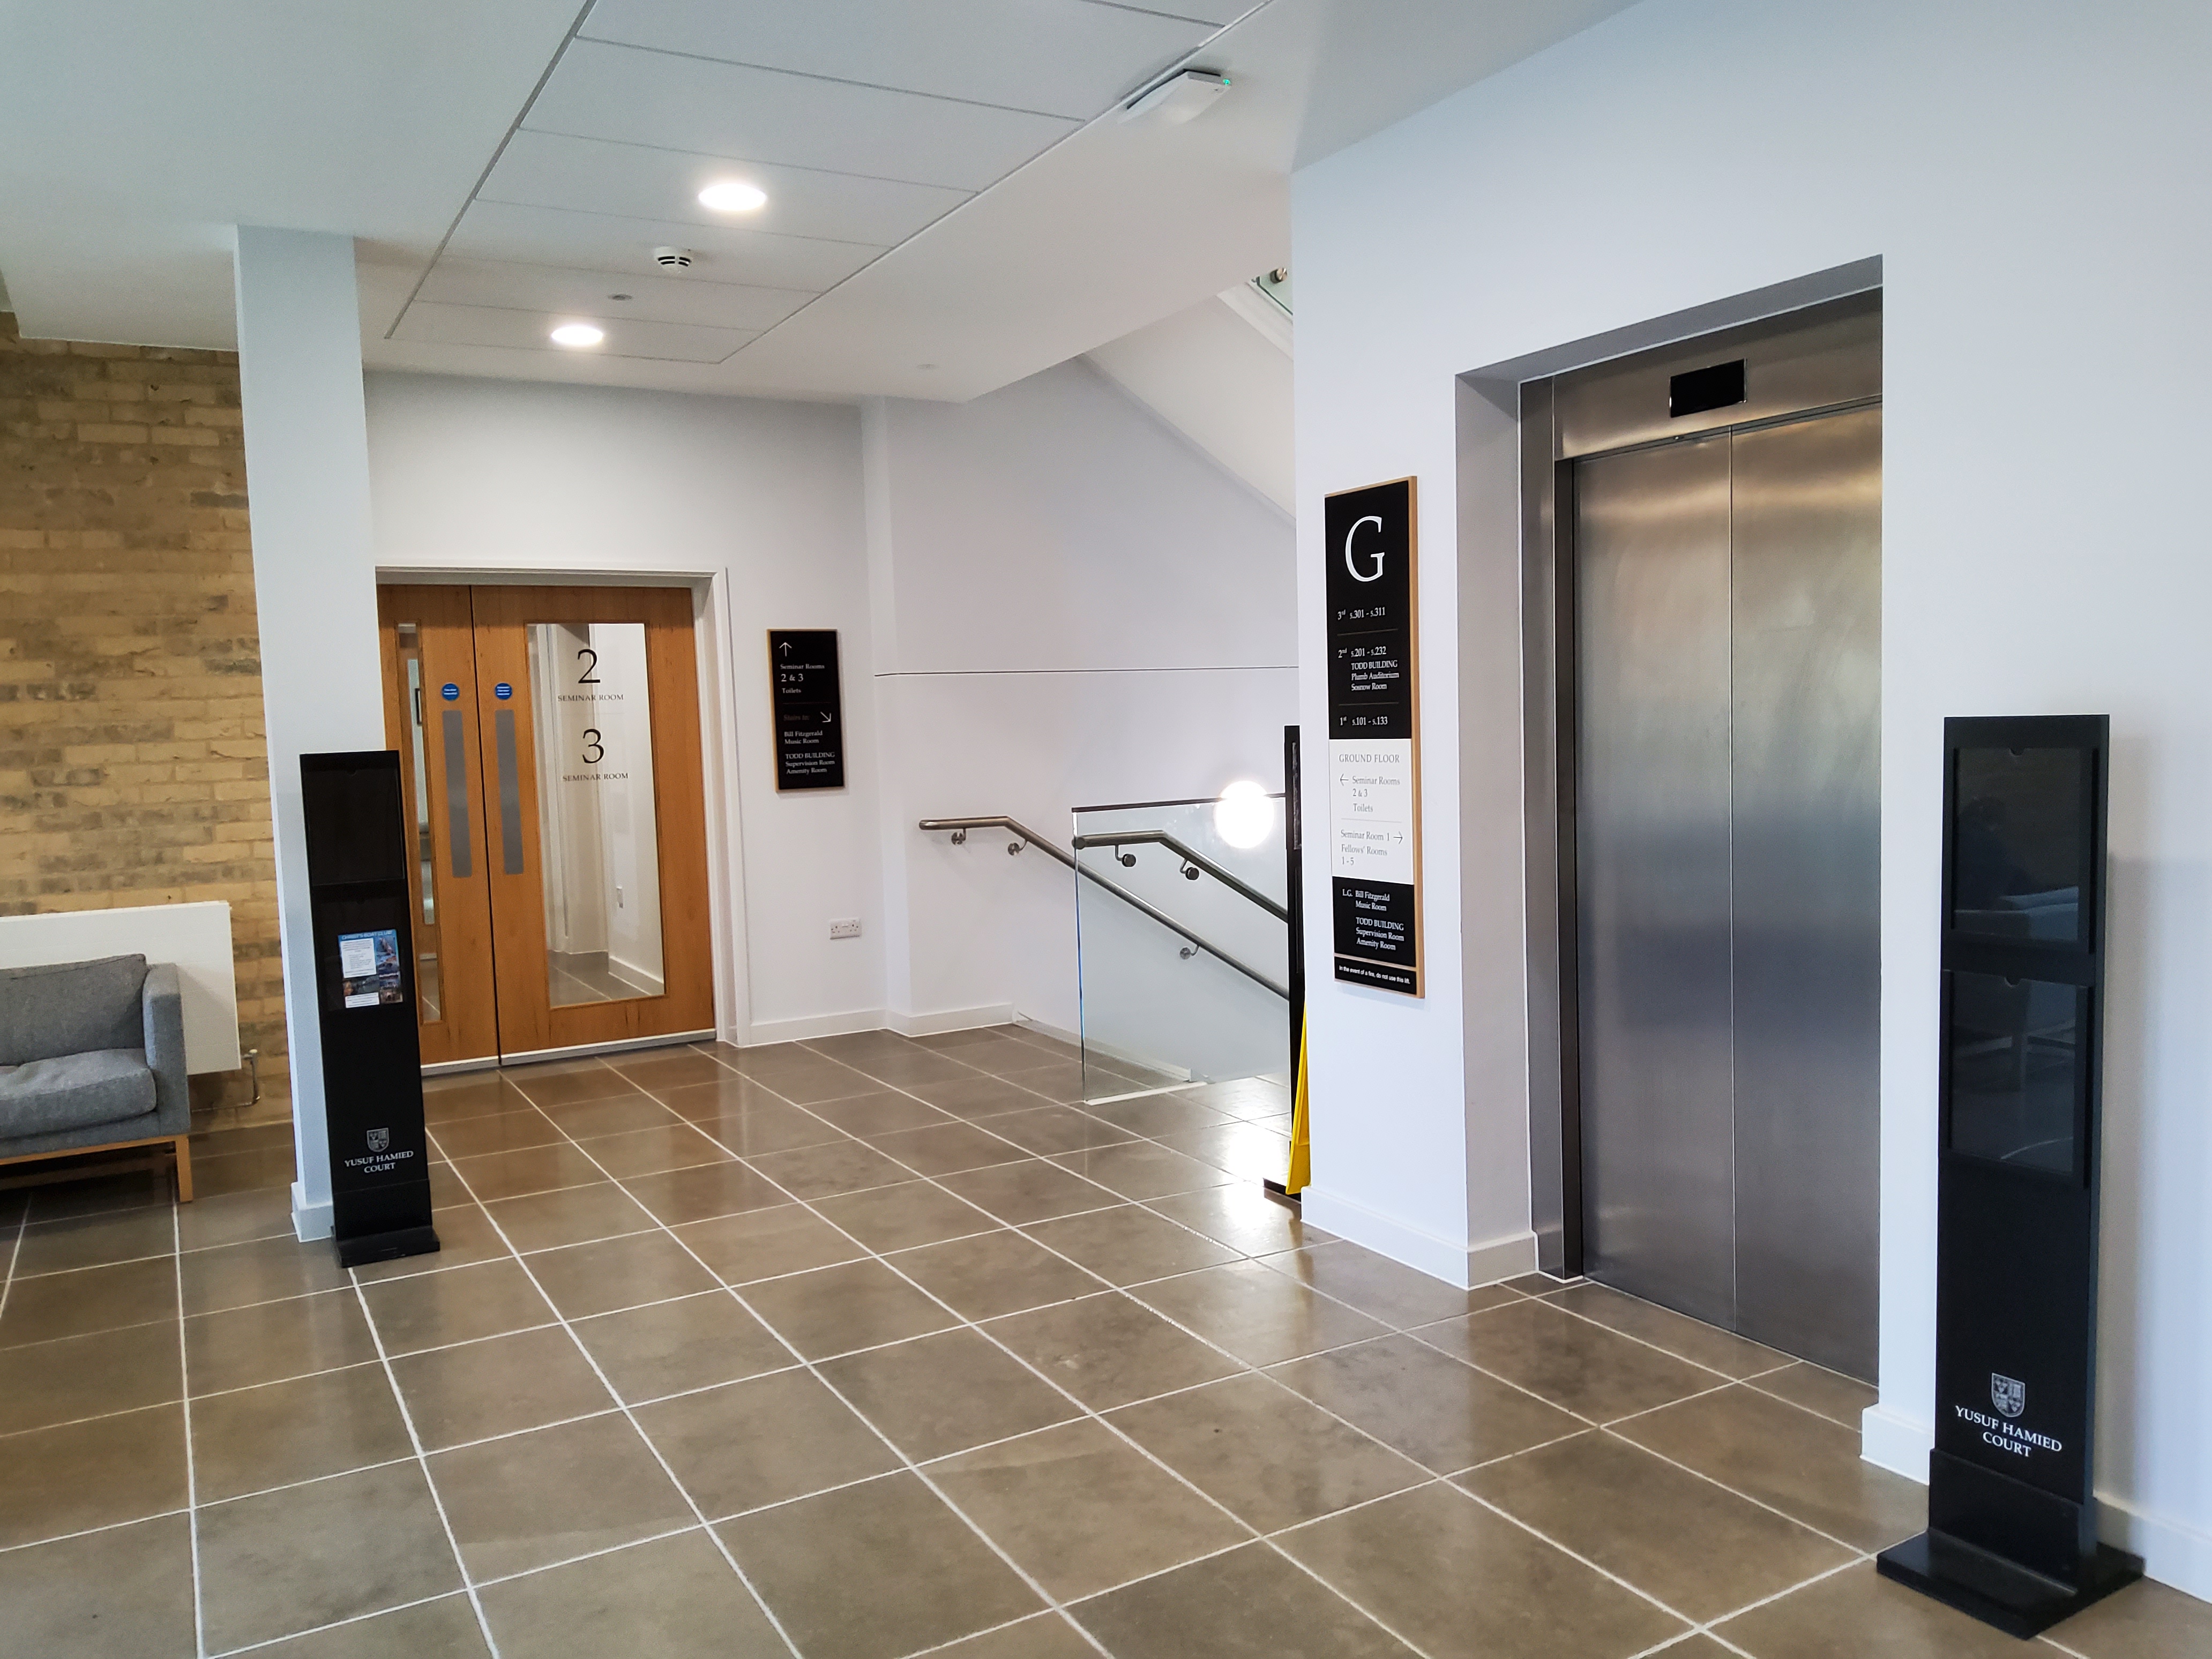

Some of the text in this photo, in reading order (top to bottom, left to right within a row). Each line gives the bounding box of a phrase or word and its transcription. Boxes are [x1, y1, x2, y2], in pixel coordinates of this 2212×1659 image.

[1346, 515, 1385, 582] G
[577, 649, 600, 683] 2
[1351, 660, 1398, 670] TODD BUILDING
[781, 674, 787, 682] 2
[798, 673, 803, 682] 3
[1369, 671, 1399, 679] Auditorium
[1372, 682, 1387, 690] Room
[582, 728, 604, 764] 3
[1339, 754, 1400, 763] GROUND FLOOR
[563, 773, 601, 782] SEMINAR
[1352, 776, 1400, 785] Seminar Rooms
[1352, 788, 1356, 797] 2
[1364, 789, 1367, 797] 3
[1353, 803, 1373, 812] Toilets
[1341, 829, 1389, 841] Seminar Room 1
[1341, 844, 1387, 856] Fellows' Rooms
[1342, 856, 1344, 865] 1
[1350, 857, 1354, 865] 5
[1342, 888, 1390, 901] L.G. Bill Fitzgerald
[1355, 900, 1387, 911] Music Room
[1356, 917, 1404, 931] TODD BUILDING
[1356, 927, 1404, 941] Supervision Room
[1356, 938, 1396, 950] Amenity Room
[344, 1150, 414, 1167] YUSUF HAMIED
[364, 1162, 396, 1174] COURT
[1955, 1405, 2062, 1452] YUSUF HAMIED
[1983, 1431, 2031, 1457] COURT
